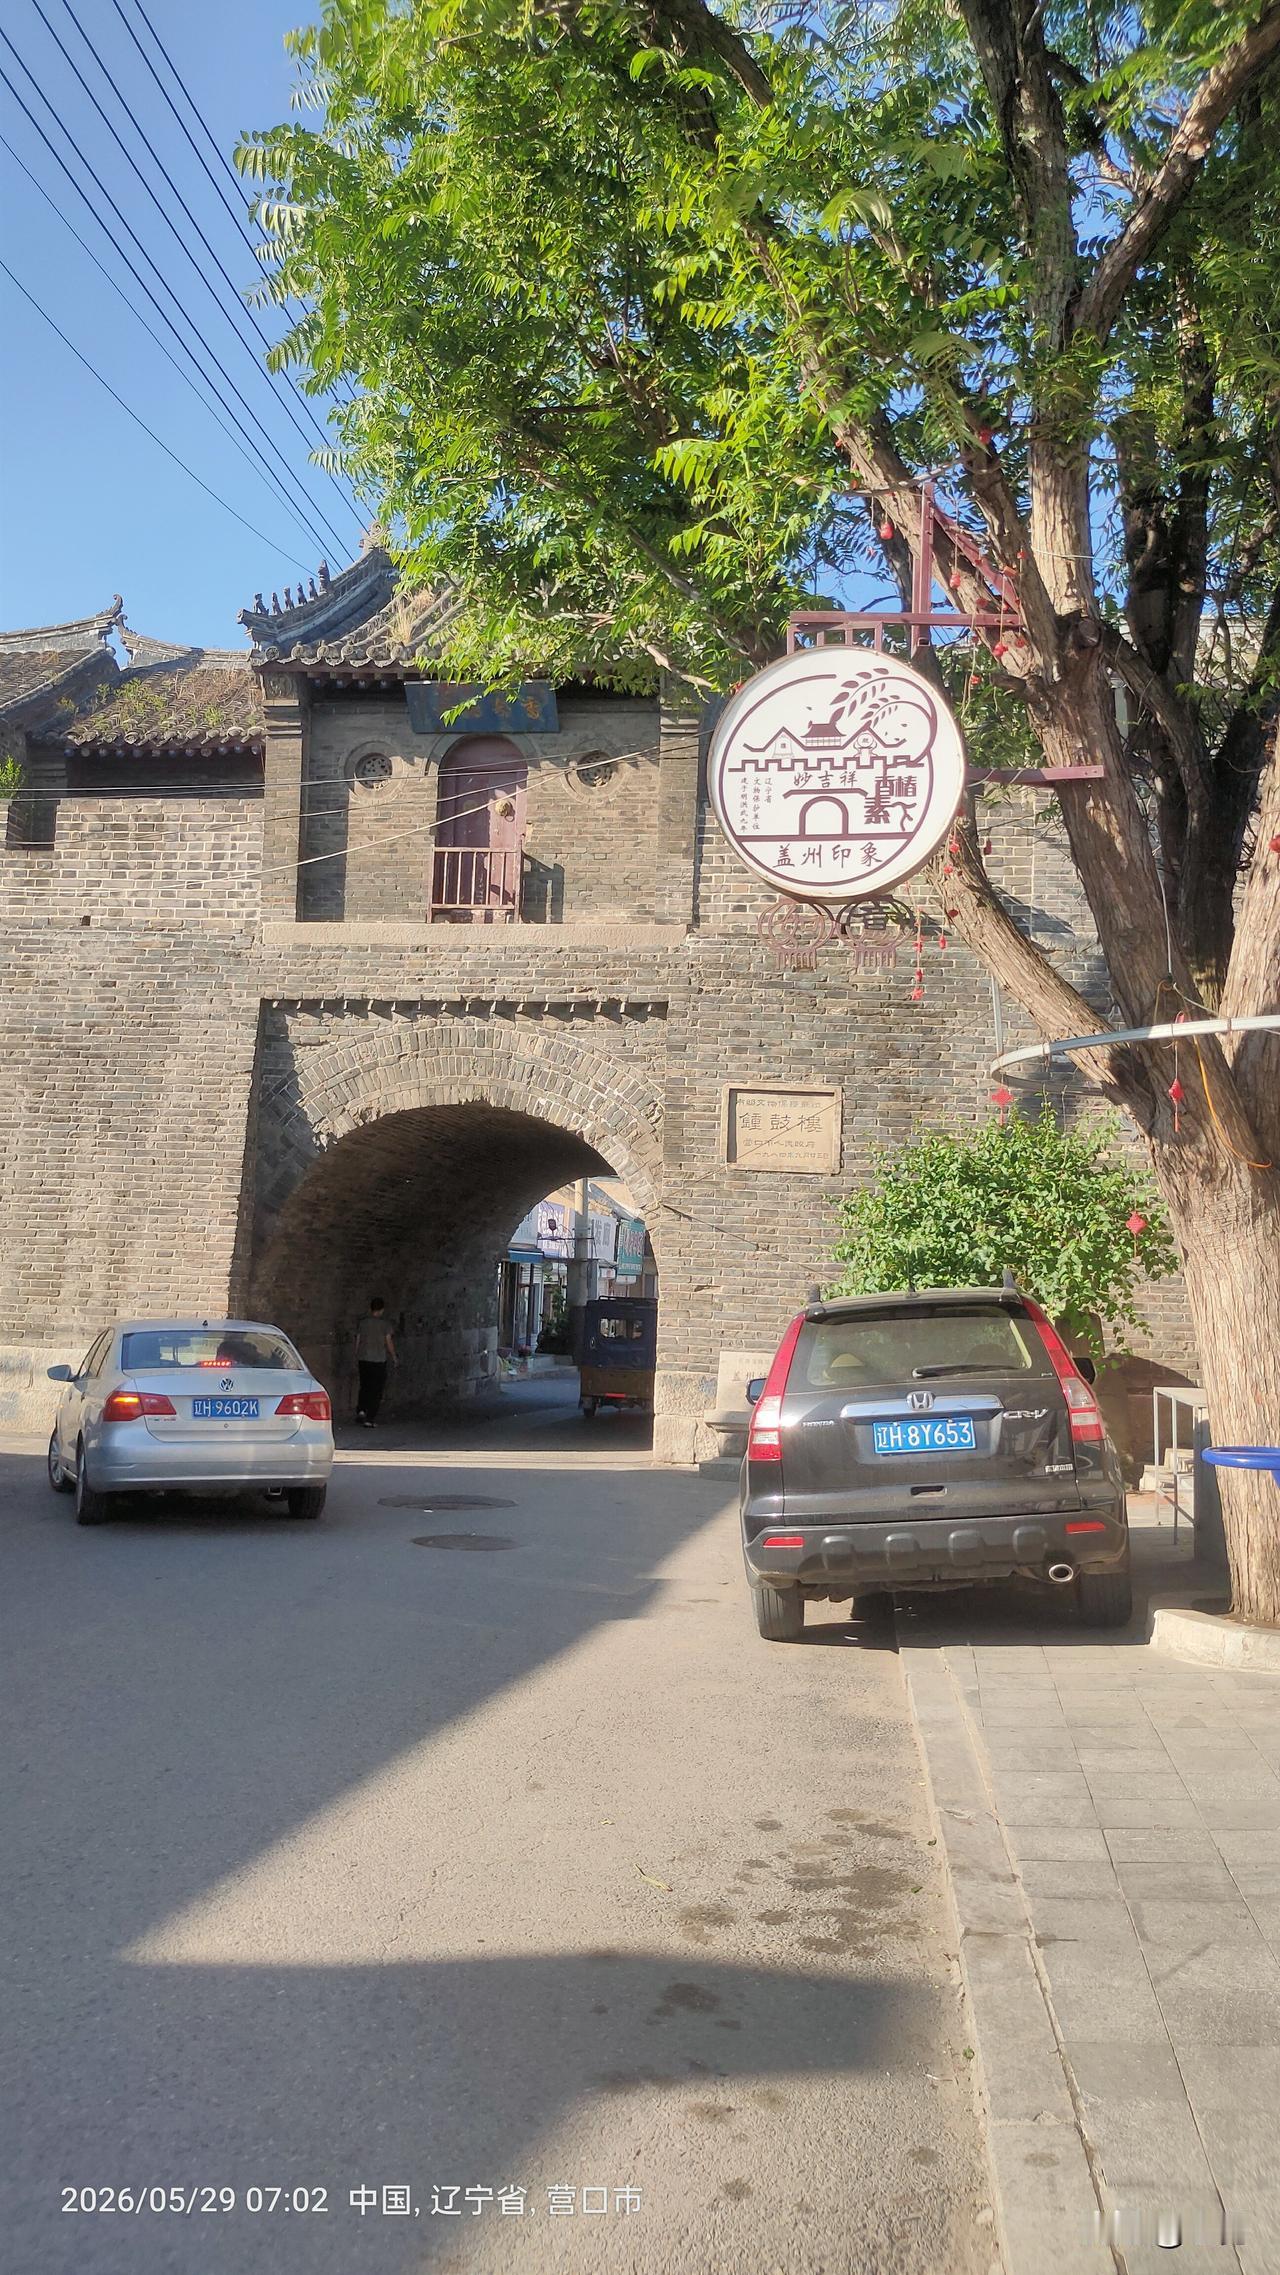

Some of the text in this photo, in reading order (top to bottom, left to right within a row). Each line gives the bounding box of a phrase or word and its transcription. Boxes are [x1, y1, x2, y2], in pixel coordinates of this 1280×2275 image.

[764, 777, 773, 803] 辽宁省
[793, 770, 859, 788] 妙吉祥
[874, 772, 918, 798] 香椿
[752, 776, 762, 830] 文物保护单位
[772, 841, 883, 868] 盖州印象
